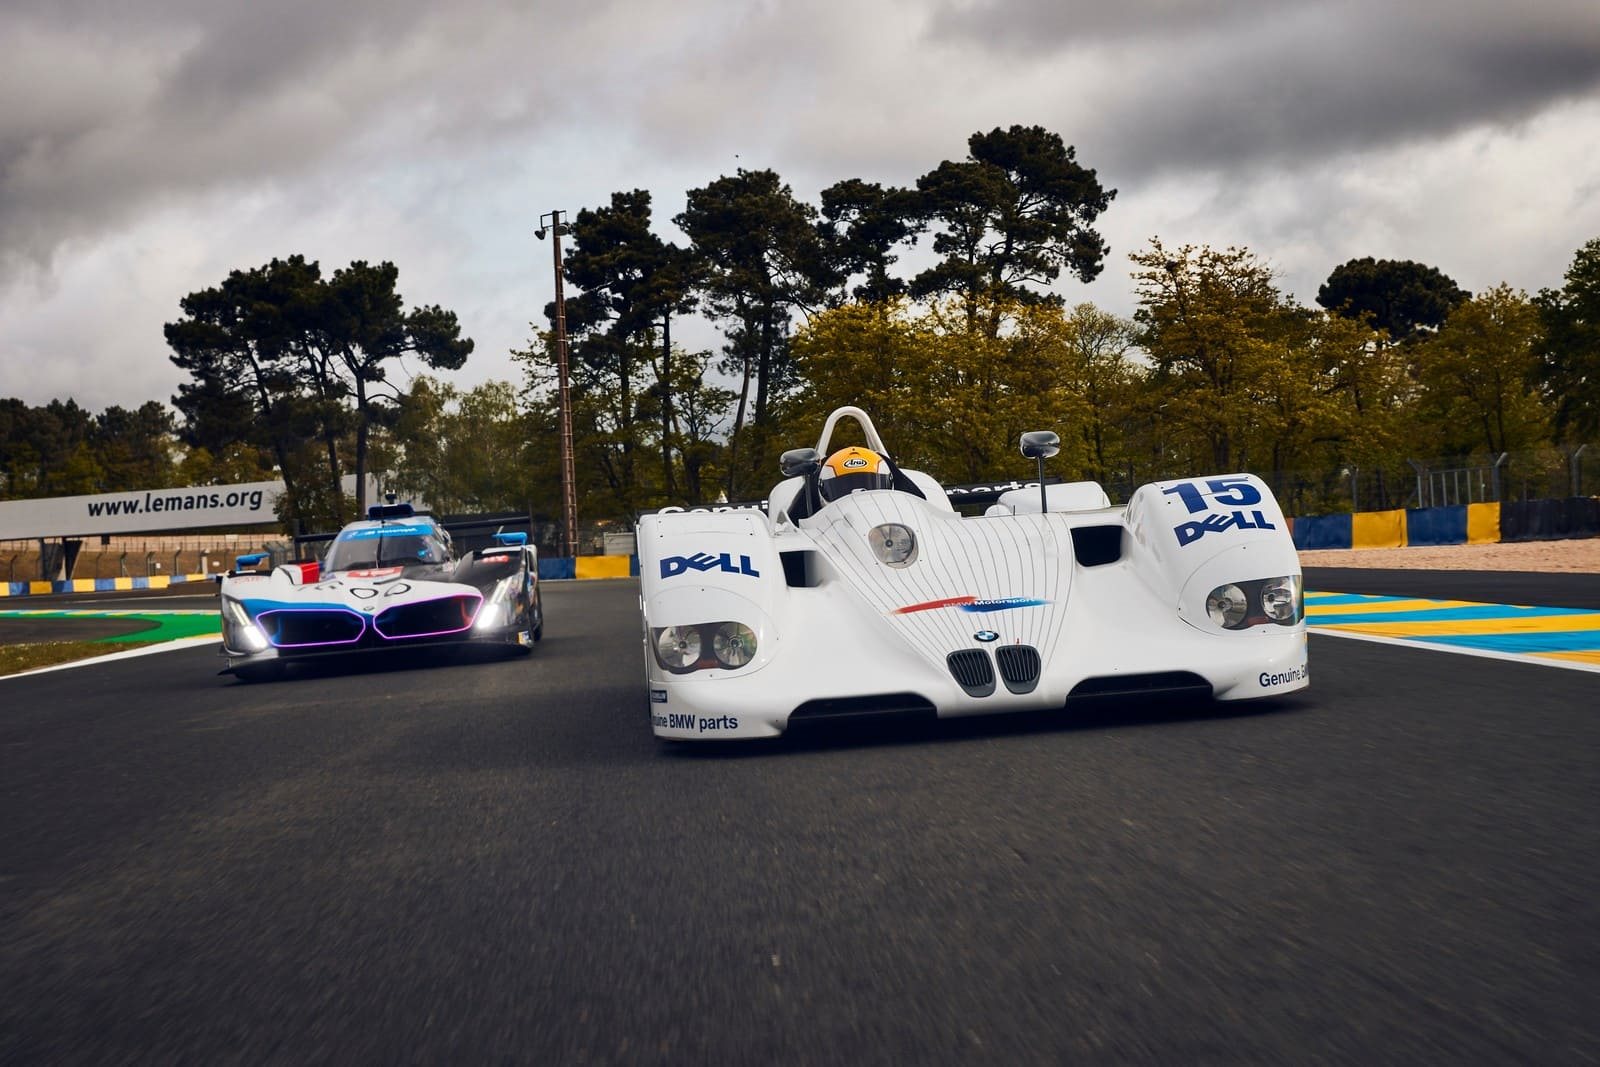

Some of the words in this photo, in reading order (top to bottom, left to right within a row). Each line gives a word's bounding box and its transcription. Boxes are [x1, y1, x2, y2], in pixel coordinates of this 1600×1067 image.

[88, 490, 263, 517] www.lemans.org
[1162, 478, 1262, 514] 15
[1174, 510, 1276, 547] DELL
[660, 552, 760, 579] DELL
[974, 598, 1037, 606] Motorsport
[1259, 667, 1301, 687] Genuine
[669, 713, 695, 729] BMW
[700, 715, 738, 733] parts
